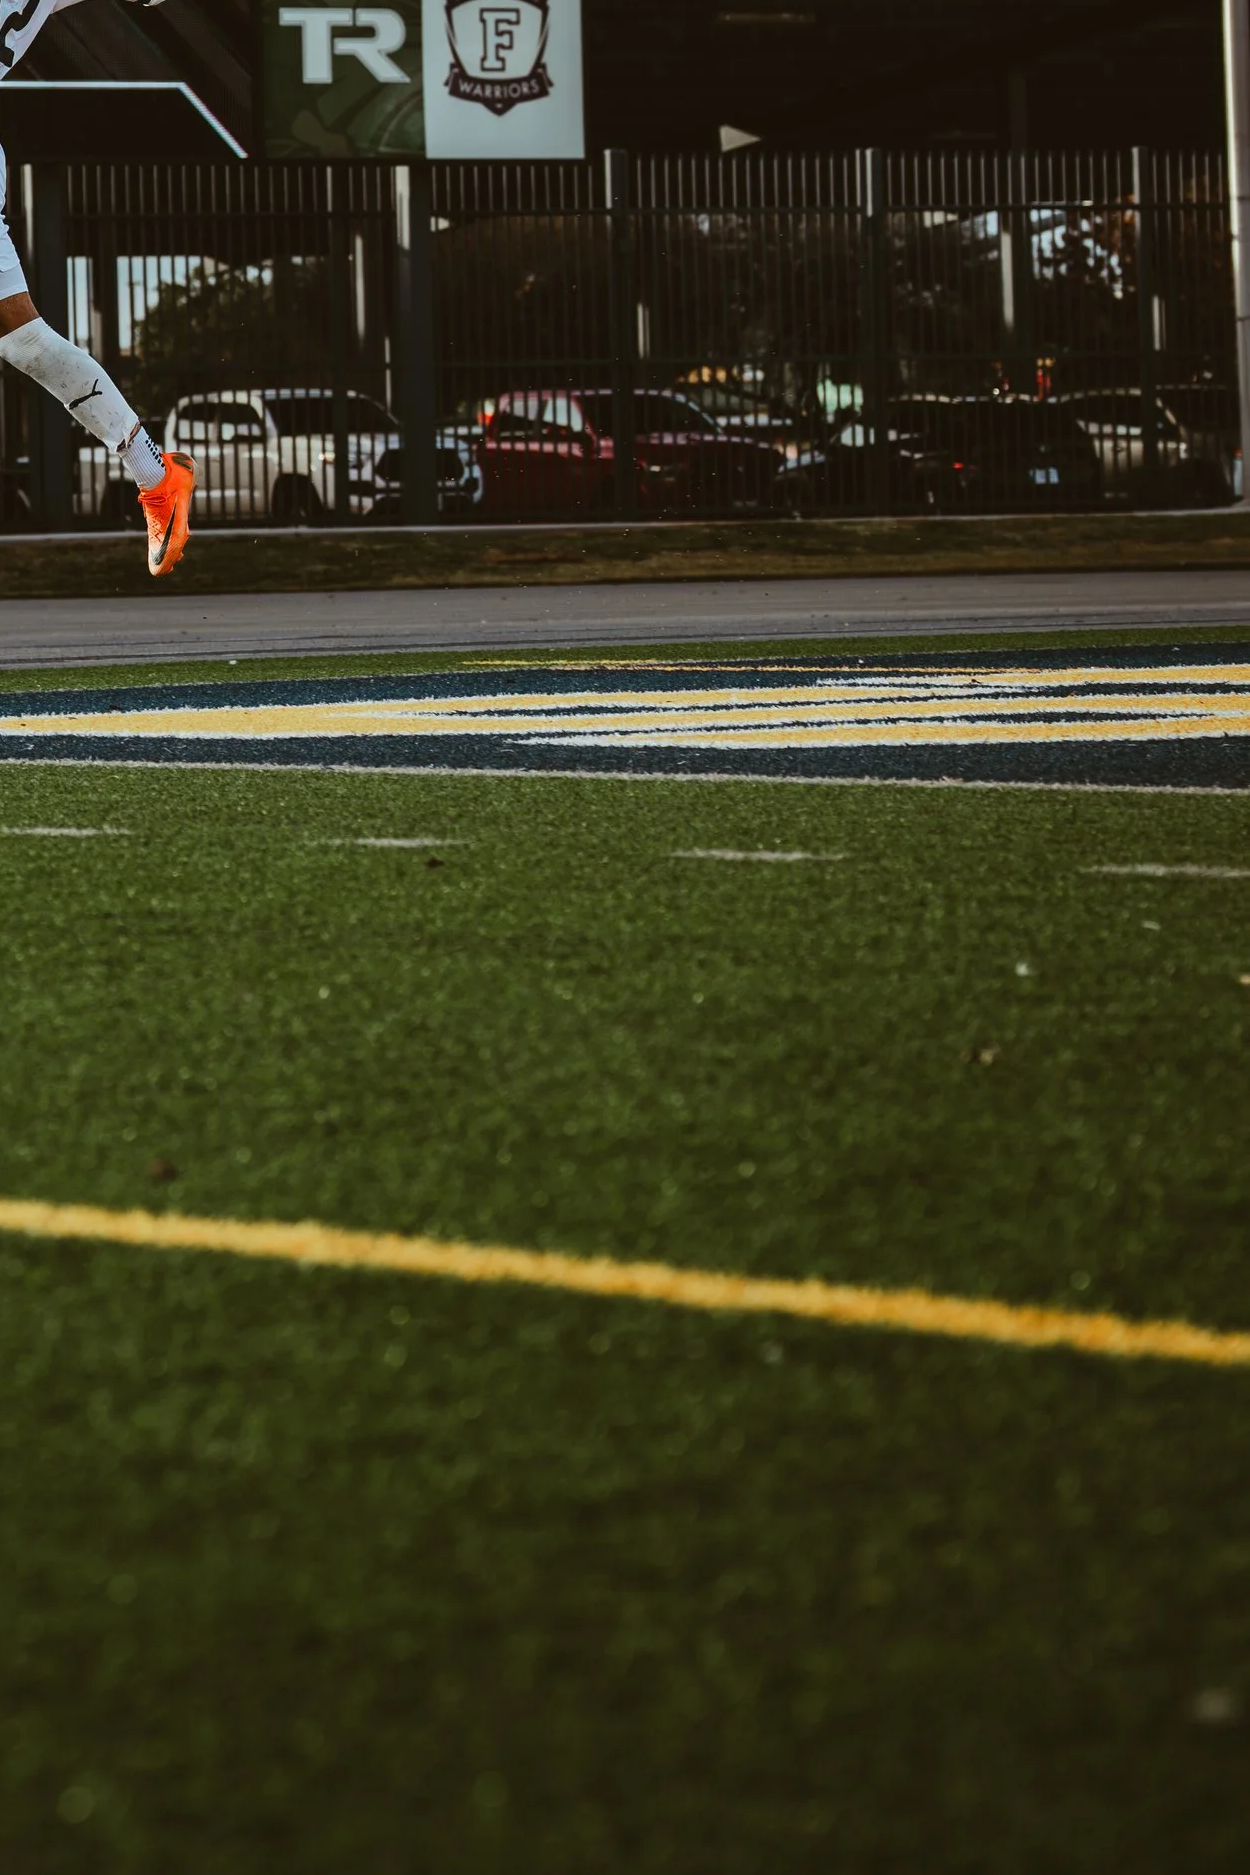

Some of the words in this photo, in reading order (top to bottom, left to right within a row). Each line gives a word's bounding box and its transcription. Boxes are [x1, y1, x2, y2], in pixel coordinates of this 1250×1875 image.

[278, 6, 412, 85] TR
[479, 8, 521, 72] F
[457, 77, 541, 100] WARRIORS
